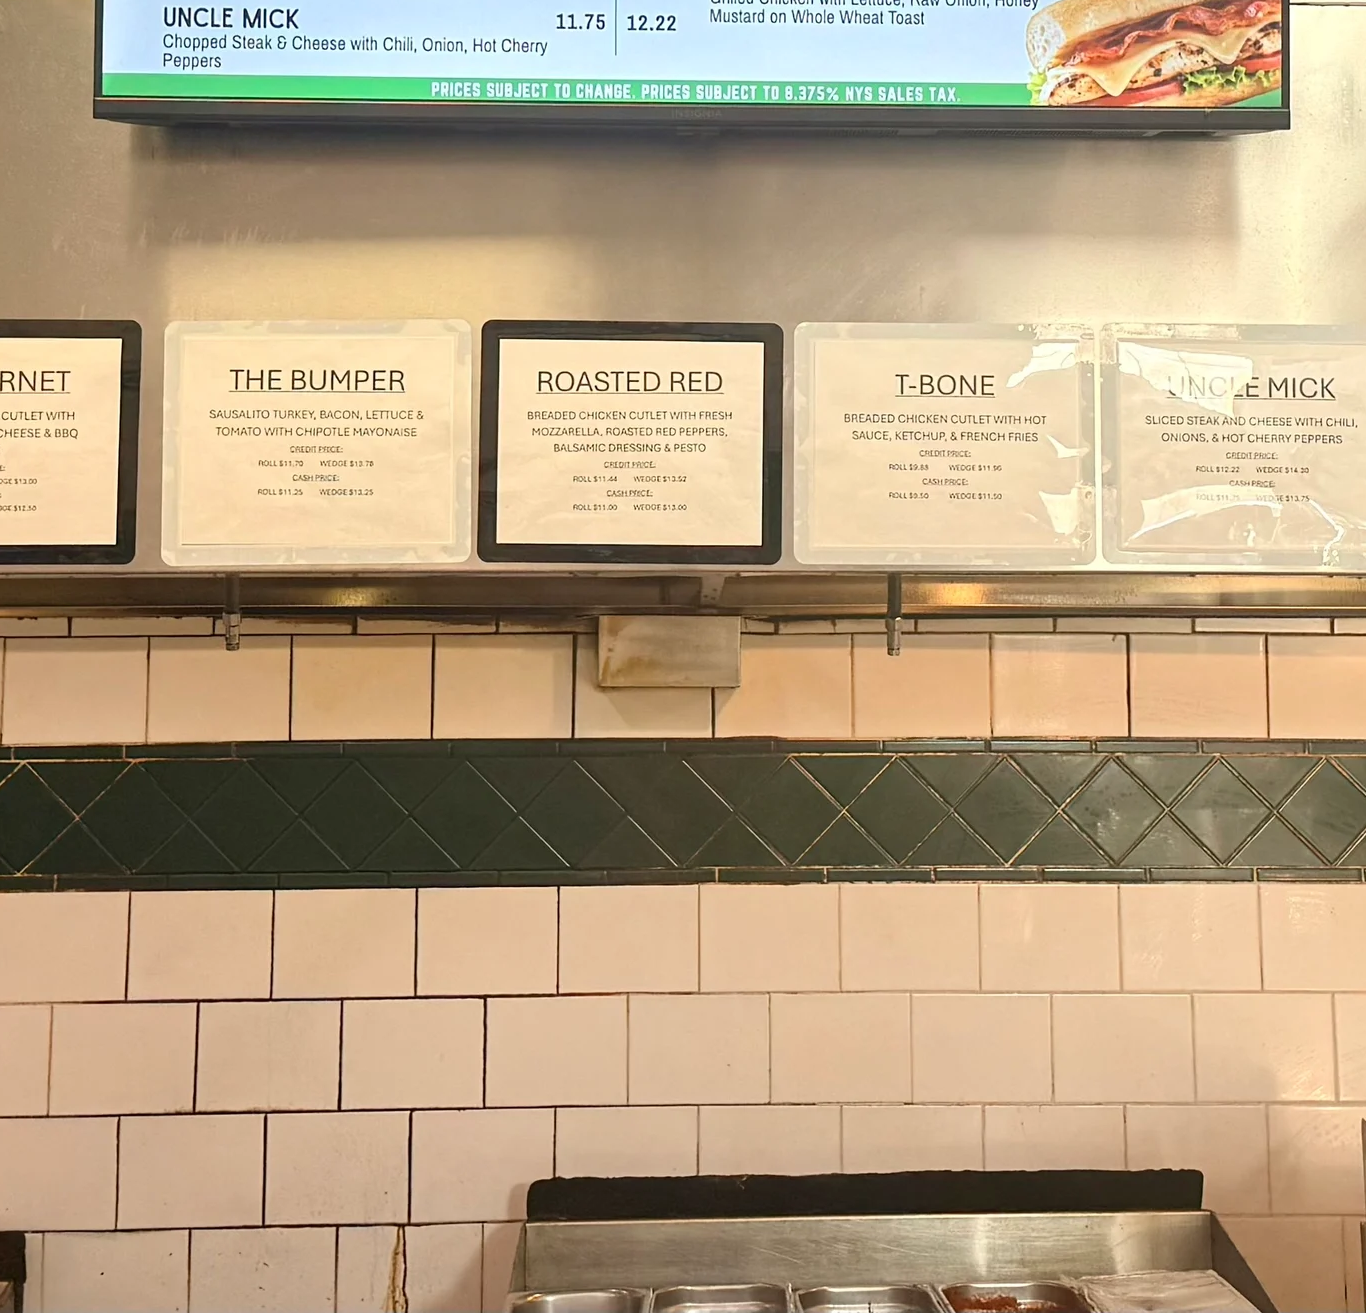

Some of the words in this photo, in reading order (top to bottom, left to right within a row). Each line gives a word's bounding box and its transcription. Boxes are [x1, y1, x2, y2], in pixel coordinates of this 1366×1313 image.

[164, 7, 233, 28] UNCLE
[243, 8, 299, 29] MICK
[229, 369, 282, 390] THE
[291, 370, 404, 393] BUMPER
[538, 371, 660, 392] ROASTED
[671, 371, 724, 394] RED
[895, 374, 995, 398] T-BONE
[1268, 377, 1336, 399] MICK
[852, 430, 892, 441] SAUCE,
[895, 431, 947, 442] KETCHUP,
[950, 431, 958, 441] &
[960, 431, 1005, 441] FRENCH
[1008, 432, 1038, 442] FRIES
